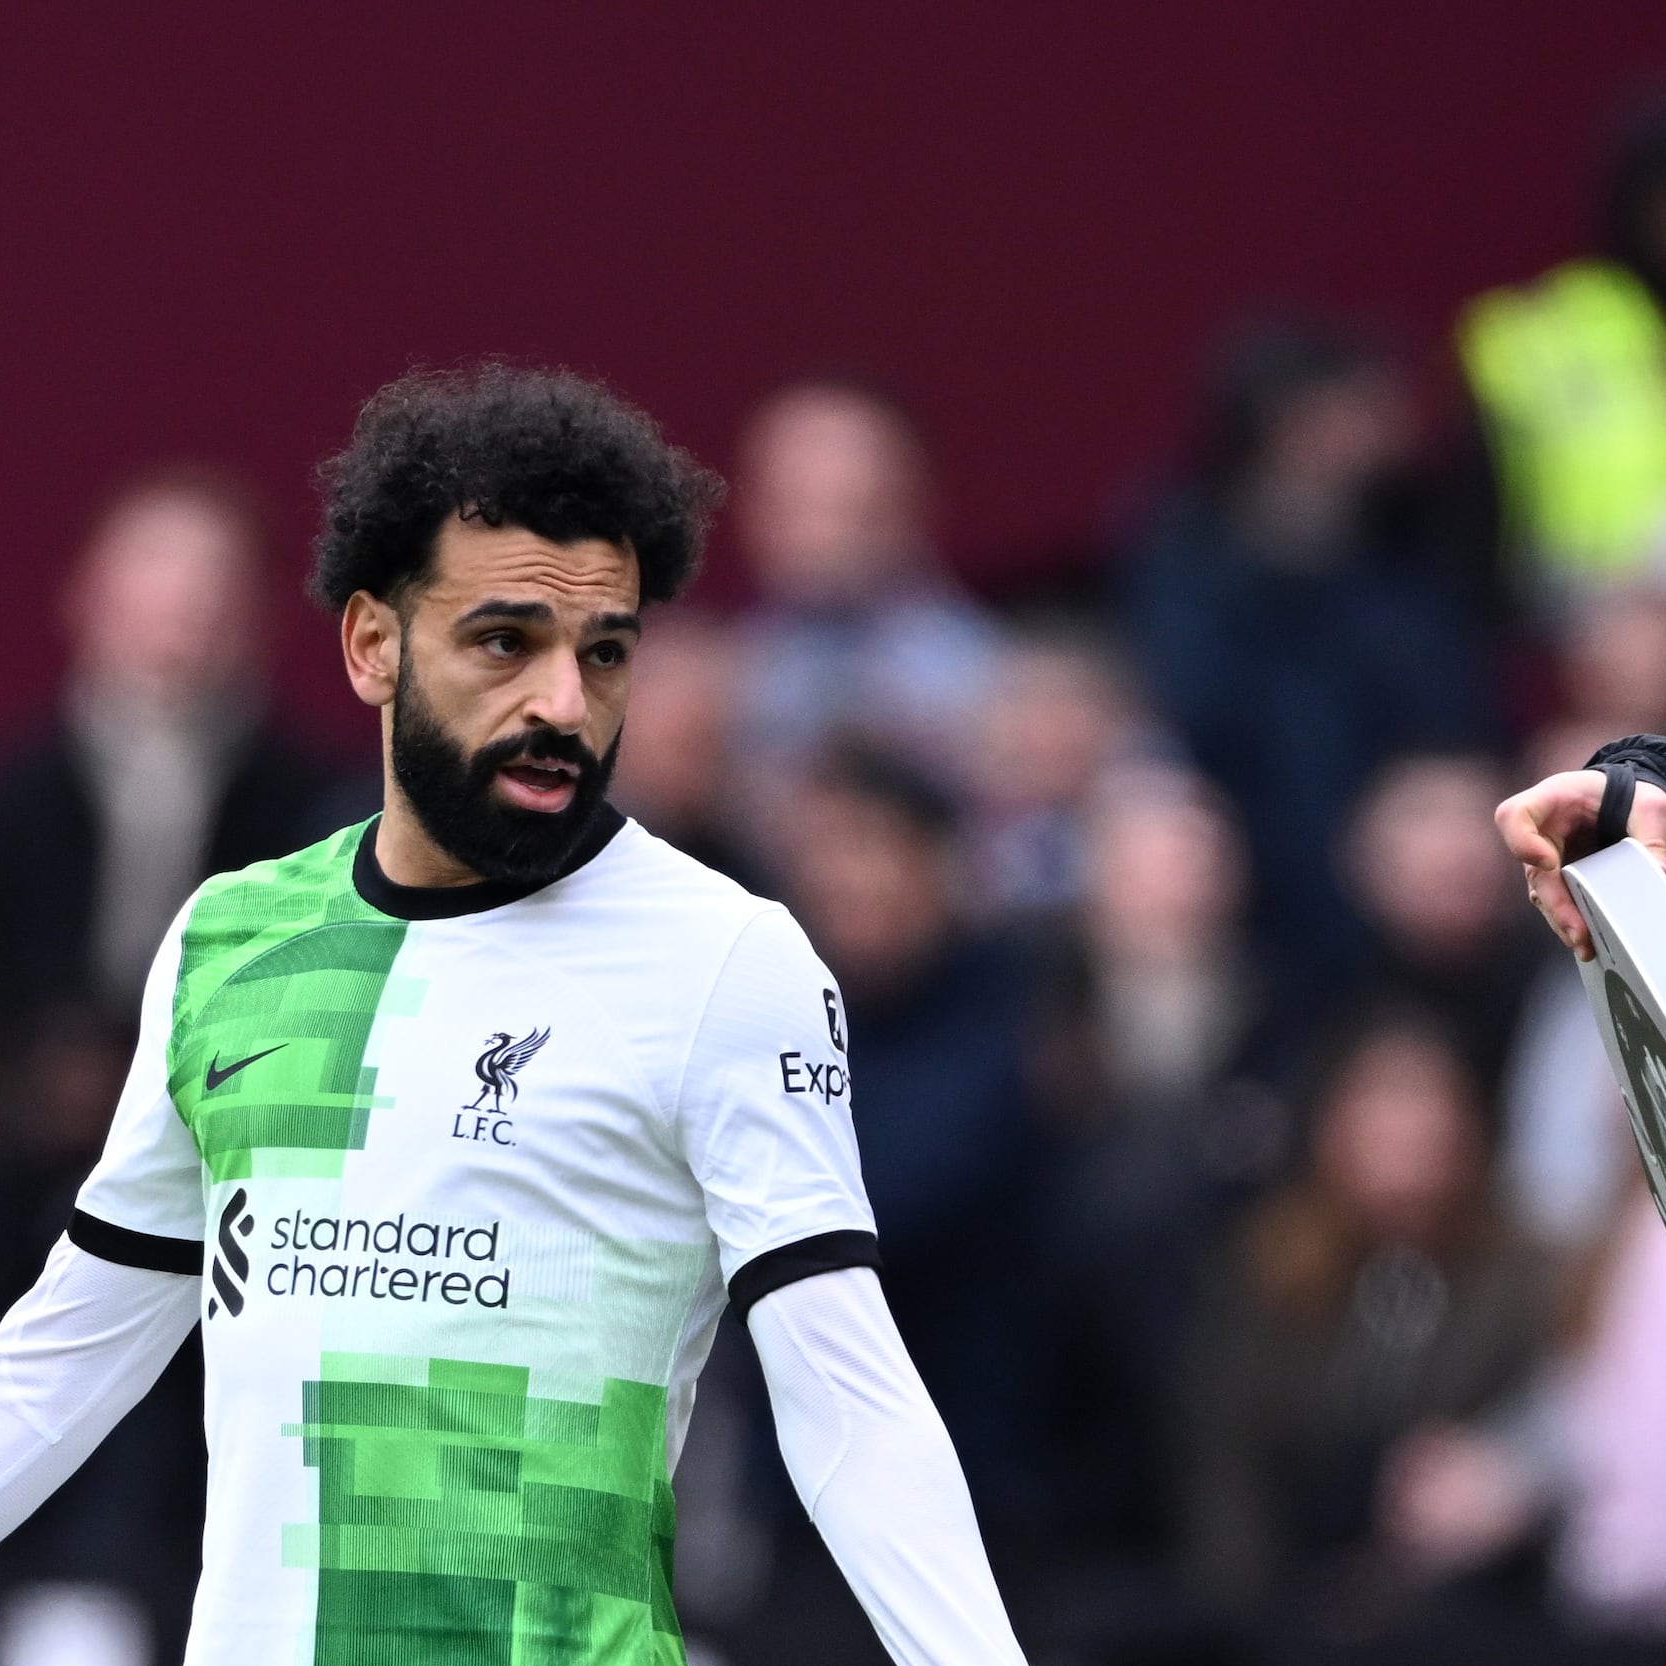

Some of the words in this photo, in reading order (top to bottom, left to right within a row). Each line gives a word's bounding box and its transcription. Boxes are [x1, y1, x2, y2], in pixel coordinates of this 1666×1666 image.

[779, 1051, 851, 1105] Exp
[270, 1208, 500, 1262] standard
[267, 1254, 511, 1309] chartered
